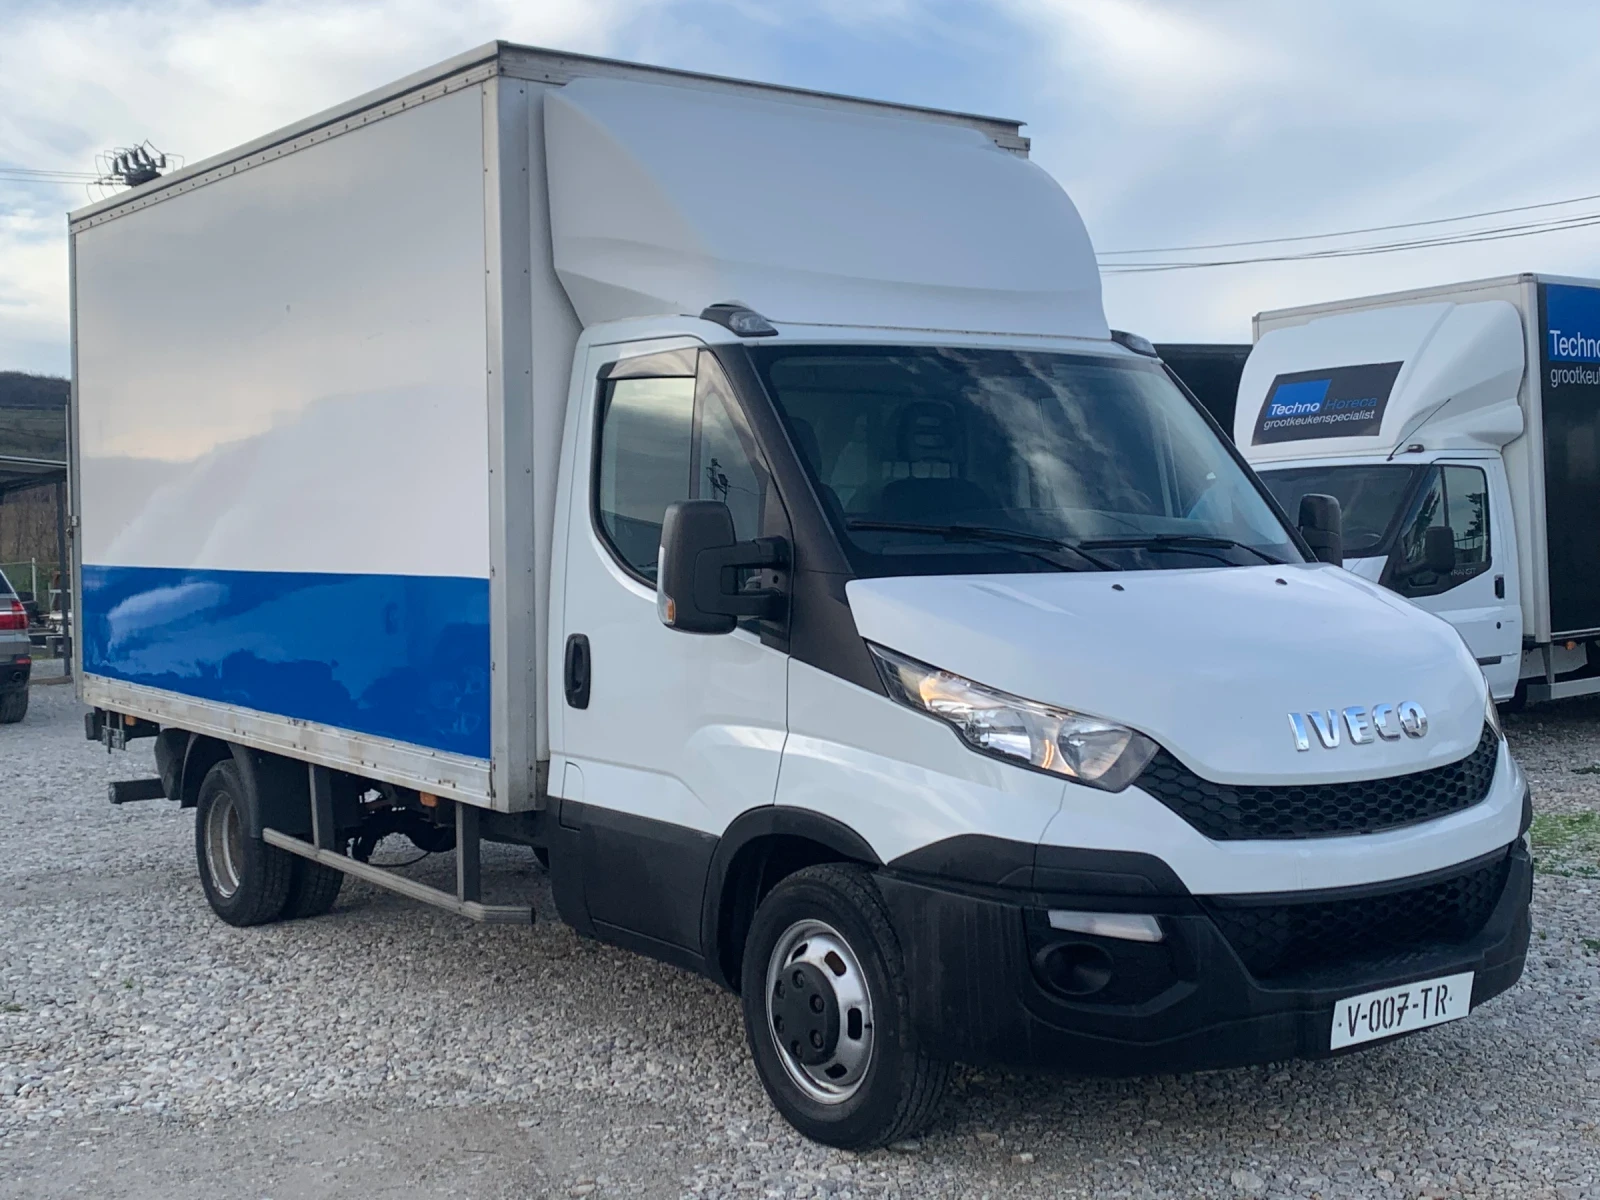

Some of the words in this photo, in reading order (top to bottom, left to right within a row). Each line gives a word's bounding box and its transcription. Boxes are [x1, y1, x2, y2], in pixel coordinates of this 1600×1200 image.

[1551, 366, 1600, 388] grootkeu
[1271, 402, 1320, 416] Techno
[1324, 398, 1377, 411] Horeca
[1263, 410, 1375, 431] grootkeukenspecialist
[1288, 701, 1428, 751] IVECO
[1347, 984, 1449, 1037] V-007-TR
